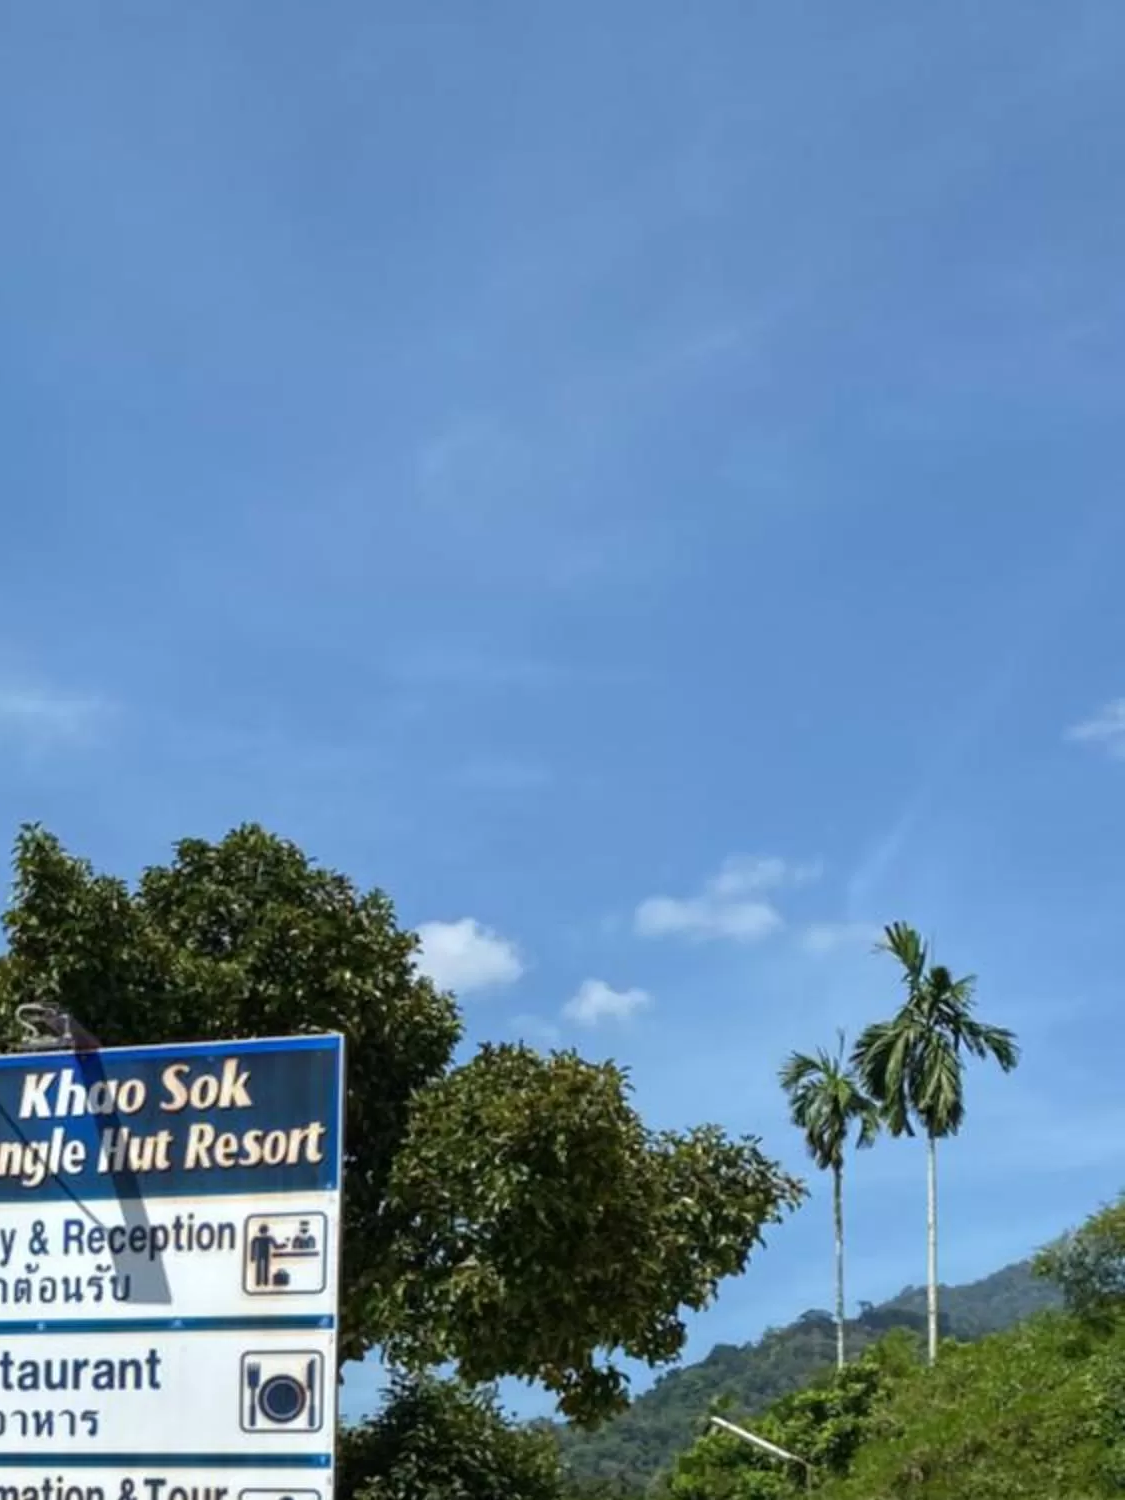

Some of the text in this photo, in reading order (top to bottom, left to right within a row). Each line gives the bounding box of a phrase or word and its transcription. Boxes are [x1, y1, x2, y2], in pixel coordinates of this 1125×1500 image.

[18, 1059, 253, 1118] Khao Sok
[97, 1125, 174, 1172] Hut
[184, 1120, 328, 1168] Resort
[29, 1221, 49, 1256] &
[62, 1214, 236, 1262] Reception
